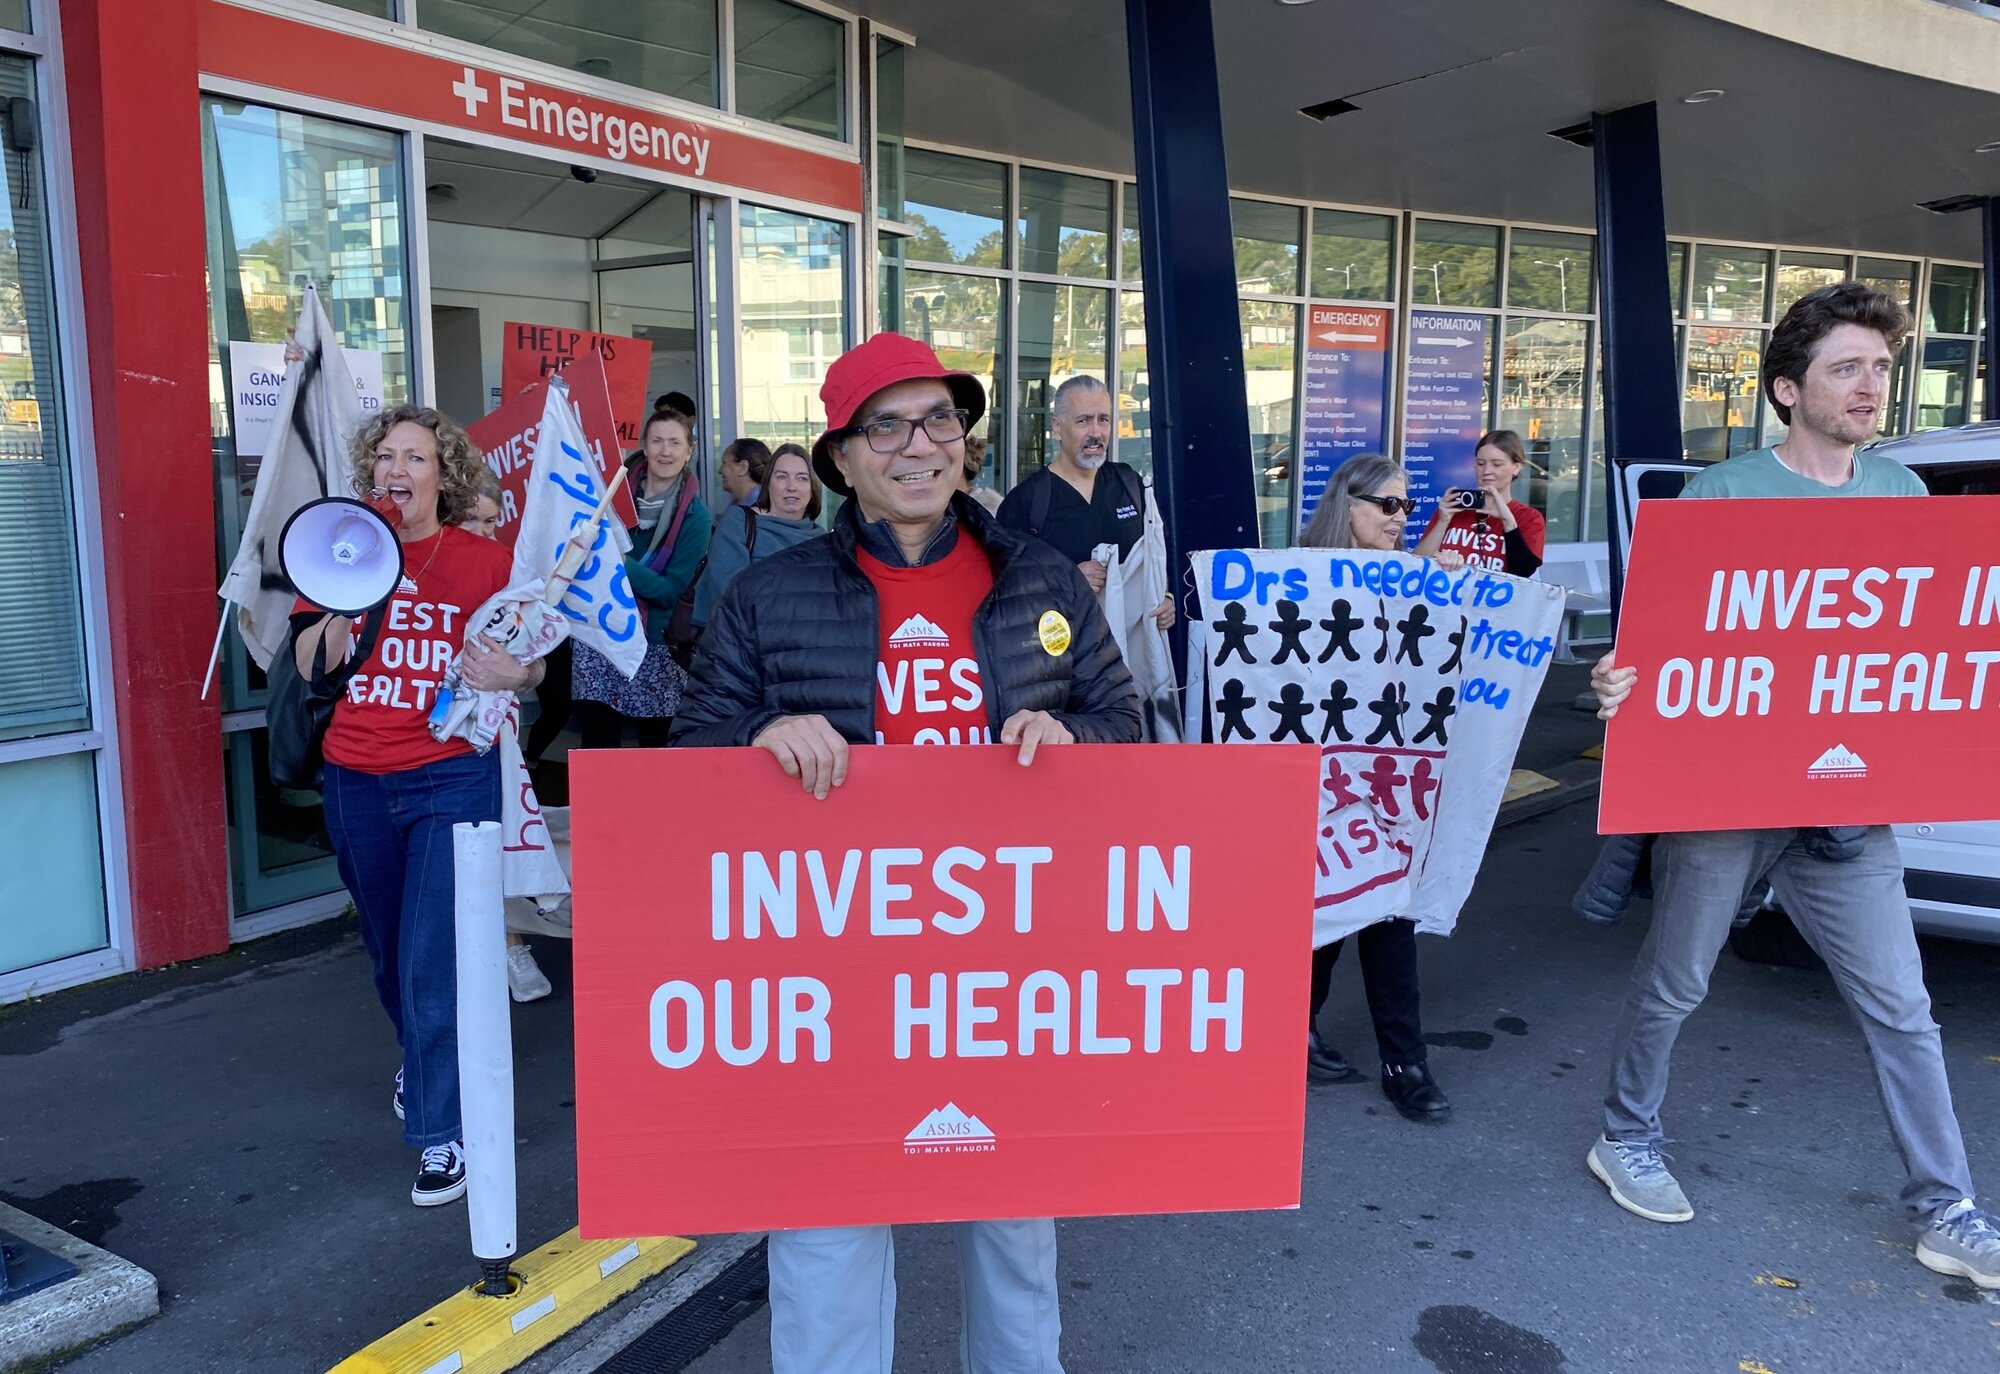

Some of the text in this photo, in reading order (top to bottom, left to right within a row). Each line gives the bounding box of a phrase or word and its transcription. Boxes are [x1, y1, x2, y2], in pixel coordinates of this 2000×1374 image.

[500, 77, 710, 176] Emergency
[1313, 311, 1381, 327] EMERGENCY
[1412, 316, 1481, 331] INFORMATION
[517, 325, 580, 356] HELP
[1308, 352, 1351, 361] Entrance To:
[1409, 356, 1438, 364] Entrance
[240, 392, 280, 406] INSIG
[356, 377, 365, 390] &
[481, 421, 541, 479] NVES
[1212, 550, 1308, 606] Drs
[1473, 575, 1514, 608] to
[1705, 566, 1934, 632] INVEST
[388, 600, 462, 633] EST
[903, 626, 934, 636] ASMS
[382, 636, 453, 672] OUR
[1470, 618, 1554, 669] treat
[347, 674, 443, 710] EALT
[1656, 651, 2000, 719] OUR HEALT
[1822, 757, 1853, 767] ASMS
[711, 845, 1191, 941] INVEST IN
[649, 967, 1244, 1069] OUR HEALTH
[926, 1122, 971, 1136] ASMS
[955, 1144, 996, 1152] HAUORA
